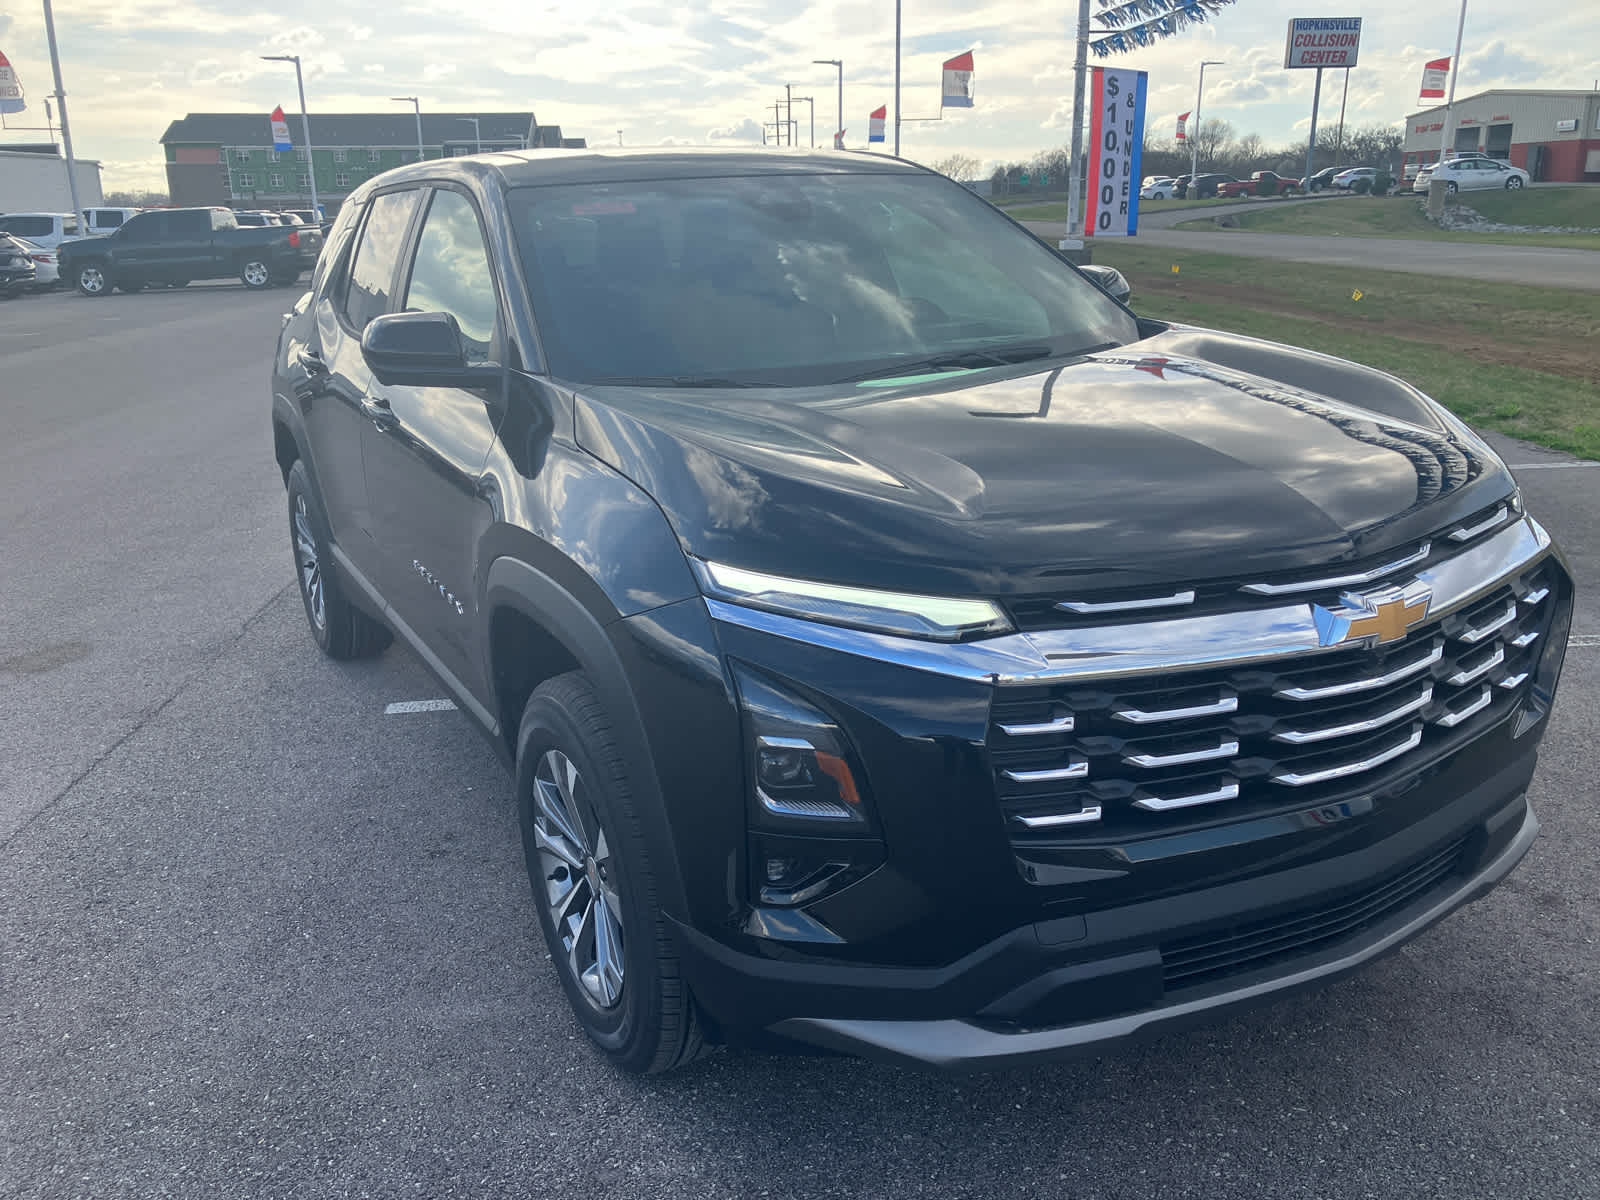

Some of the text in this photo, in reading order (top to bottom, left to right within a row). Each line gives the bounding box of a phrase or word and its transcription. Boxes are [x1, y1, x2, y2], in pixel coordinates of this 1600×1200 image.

[1295, 20, 1359, 30] HOPKINSVILLE
[1294, 33, 1357, 47] COLLISION
[1301, 50, 1347, 64] CENTER
[1099, 75, 1120, 230] $10,000
[1120, 119, 1133, 215] UNDER
